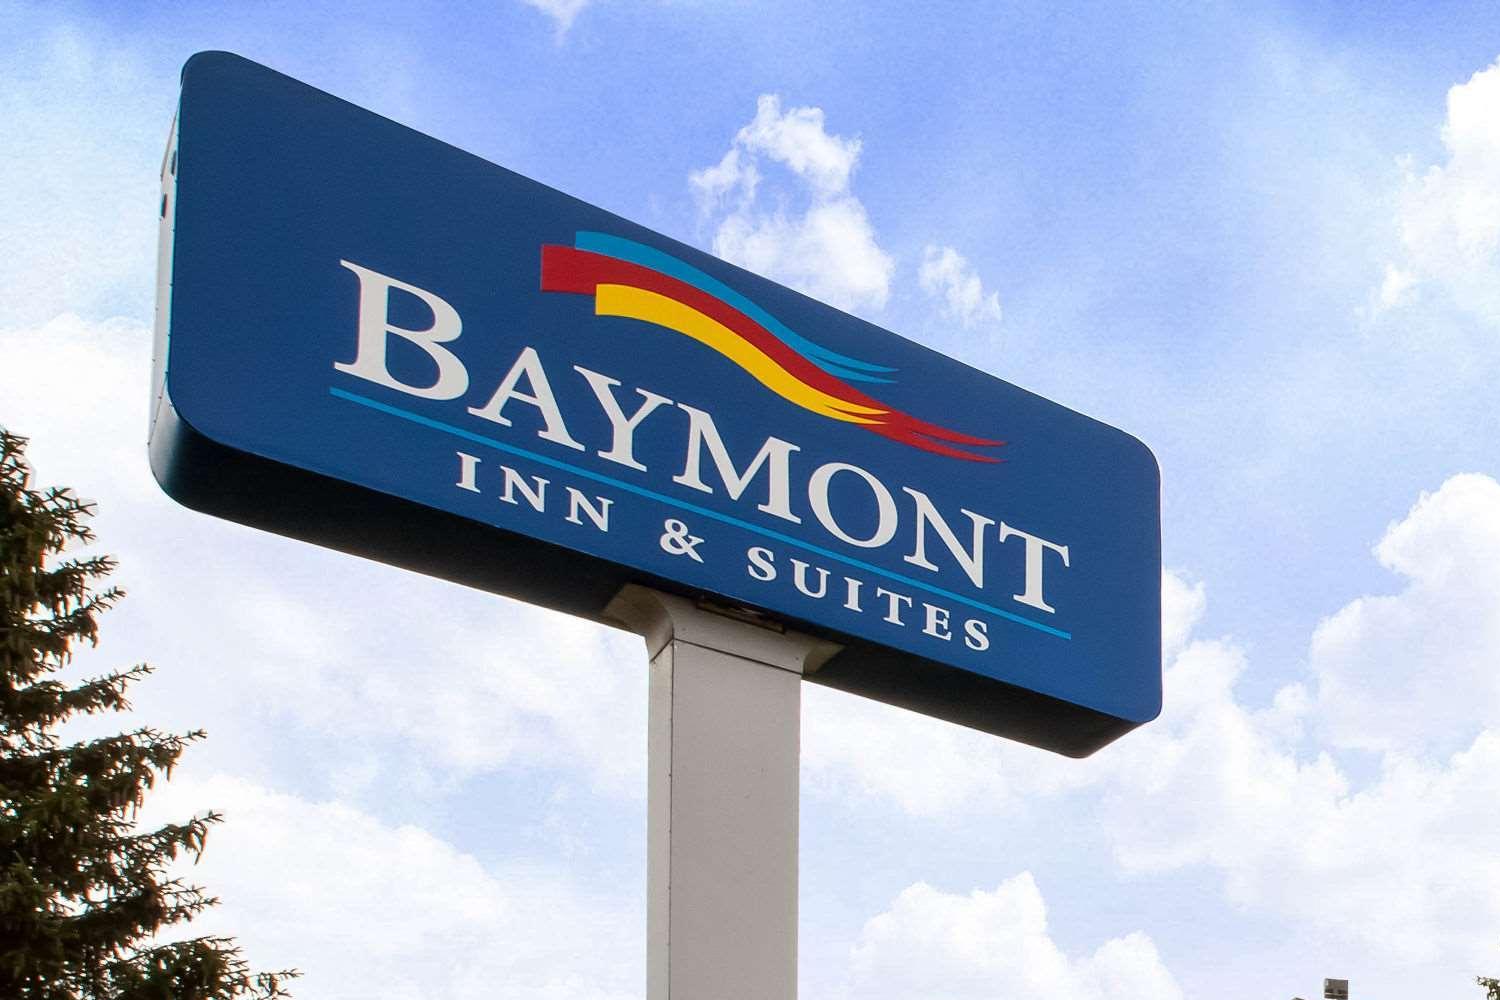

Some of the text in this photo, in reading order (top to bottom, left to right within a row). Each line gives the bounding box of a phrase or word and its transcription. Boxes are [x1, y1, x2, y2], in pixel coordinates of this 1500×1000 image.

[333, 259, 1070, 614] BAYMONT
[456, 451, 990, 652] INN & SUITES
